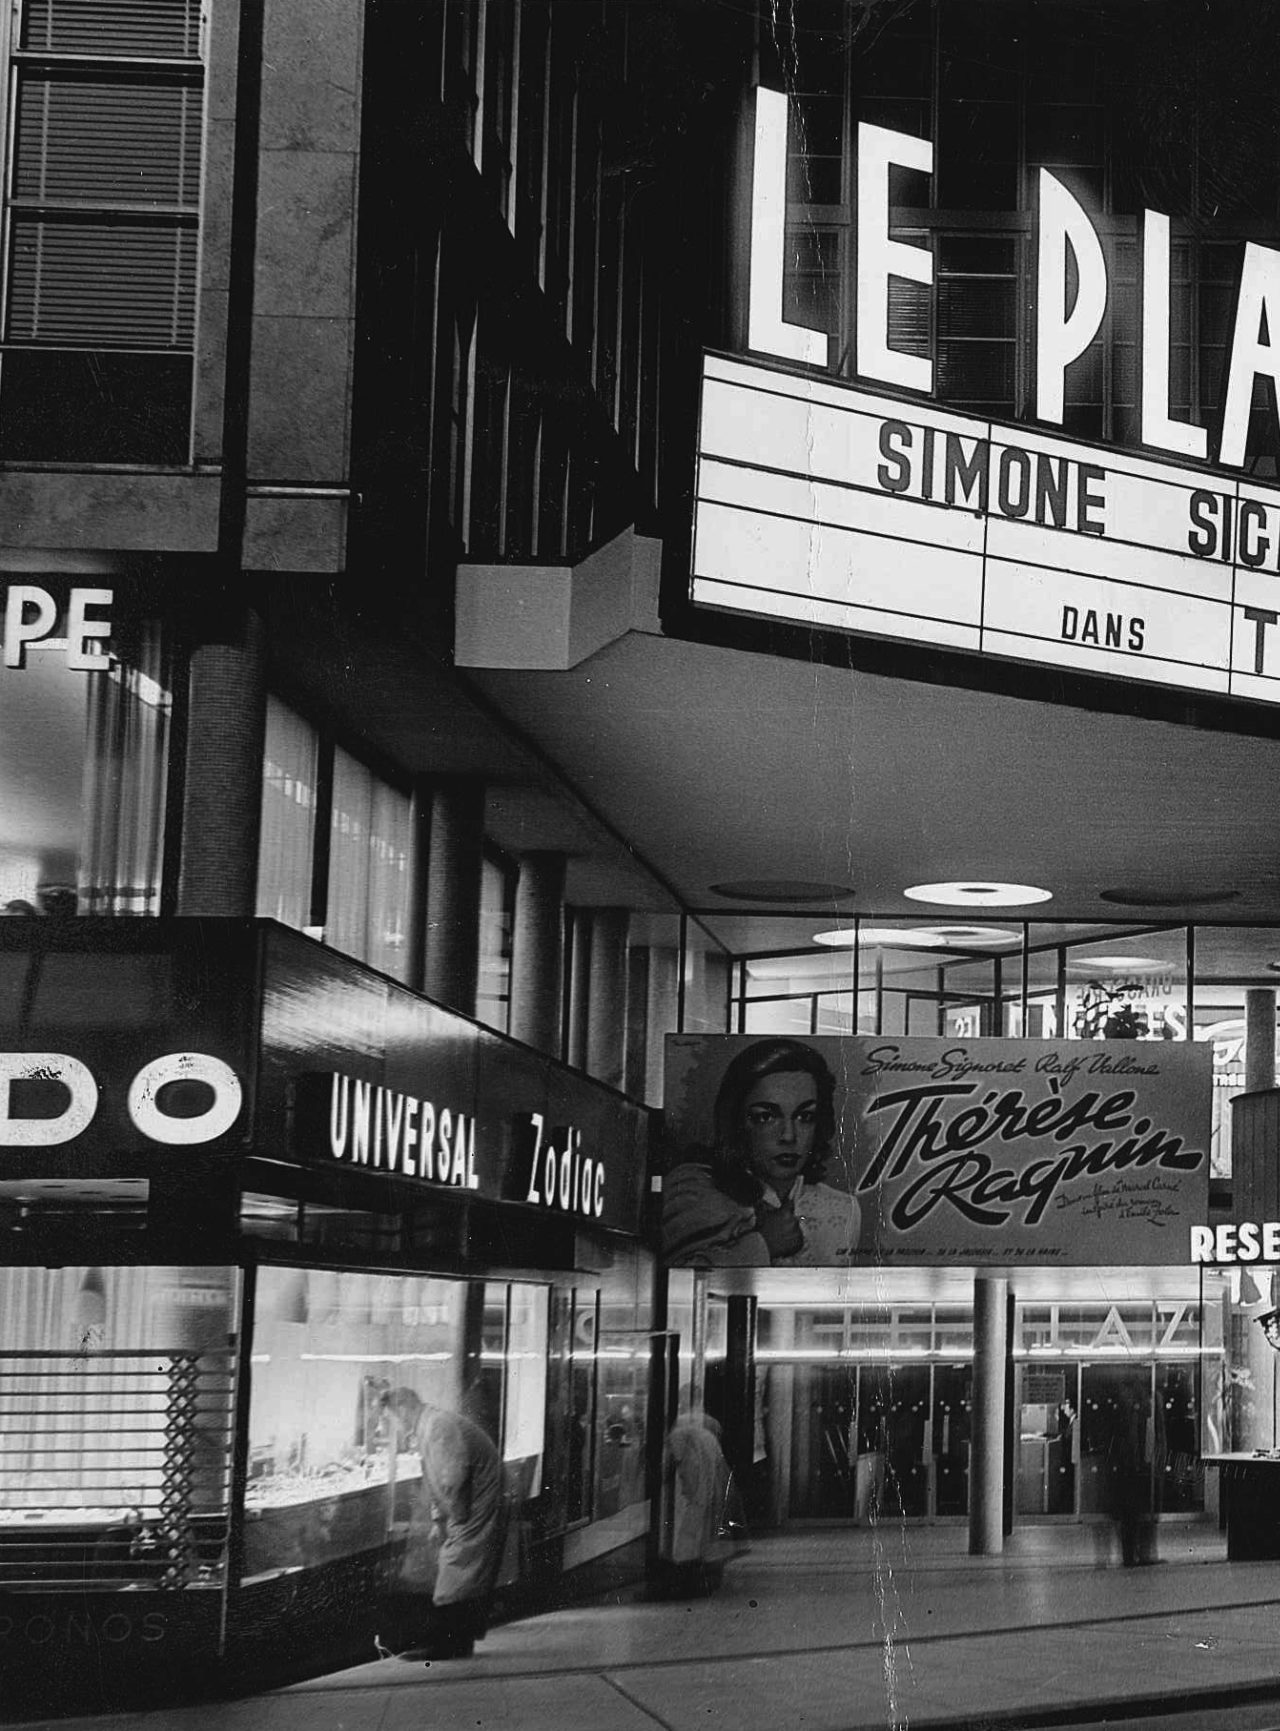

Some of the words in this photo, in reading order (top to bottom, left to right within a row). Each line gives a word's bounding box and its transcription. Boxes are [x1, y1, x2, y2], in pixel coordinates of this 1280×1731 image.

[747, 84, 934, 394] LE
[876, 420, 1106, 535] SIMONE
[3, 584, 114, 670] PE
[1061, 605, 1145, 651] DANS
[861, 1045, 938, 1076] Simone
[931, 1048, 1027, 1081] Signoret
[1083, 1052, 1160, 1076] Vallone
[330, 1071, 479, 1190] UNIVERSAL
[526, 1112, 605, 1217] Zodiac
[856, 1077, 1137, 1192] Thérèse
[891, 1118, 1203, 1230] Raquin
